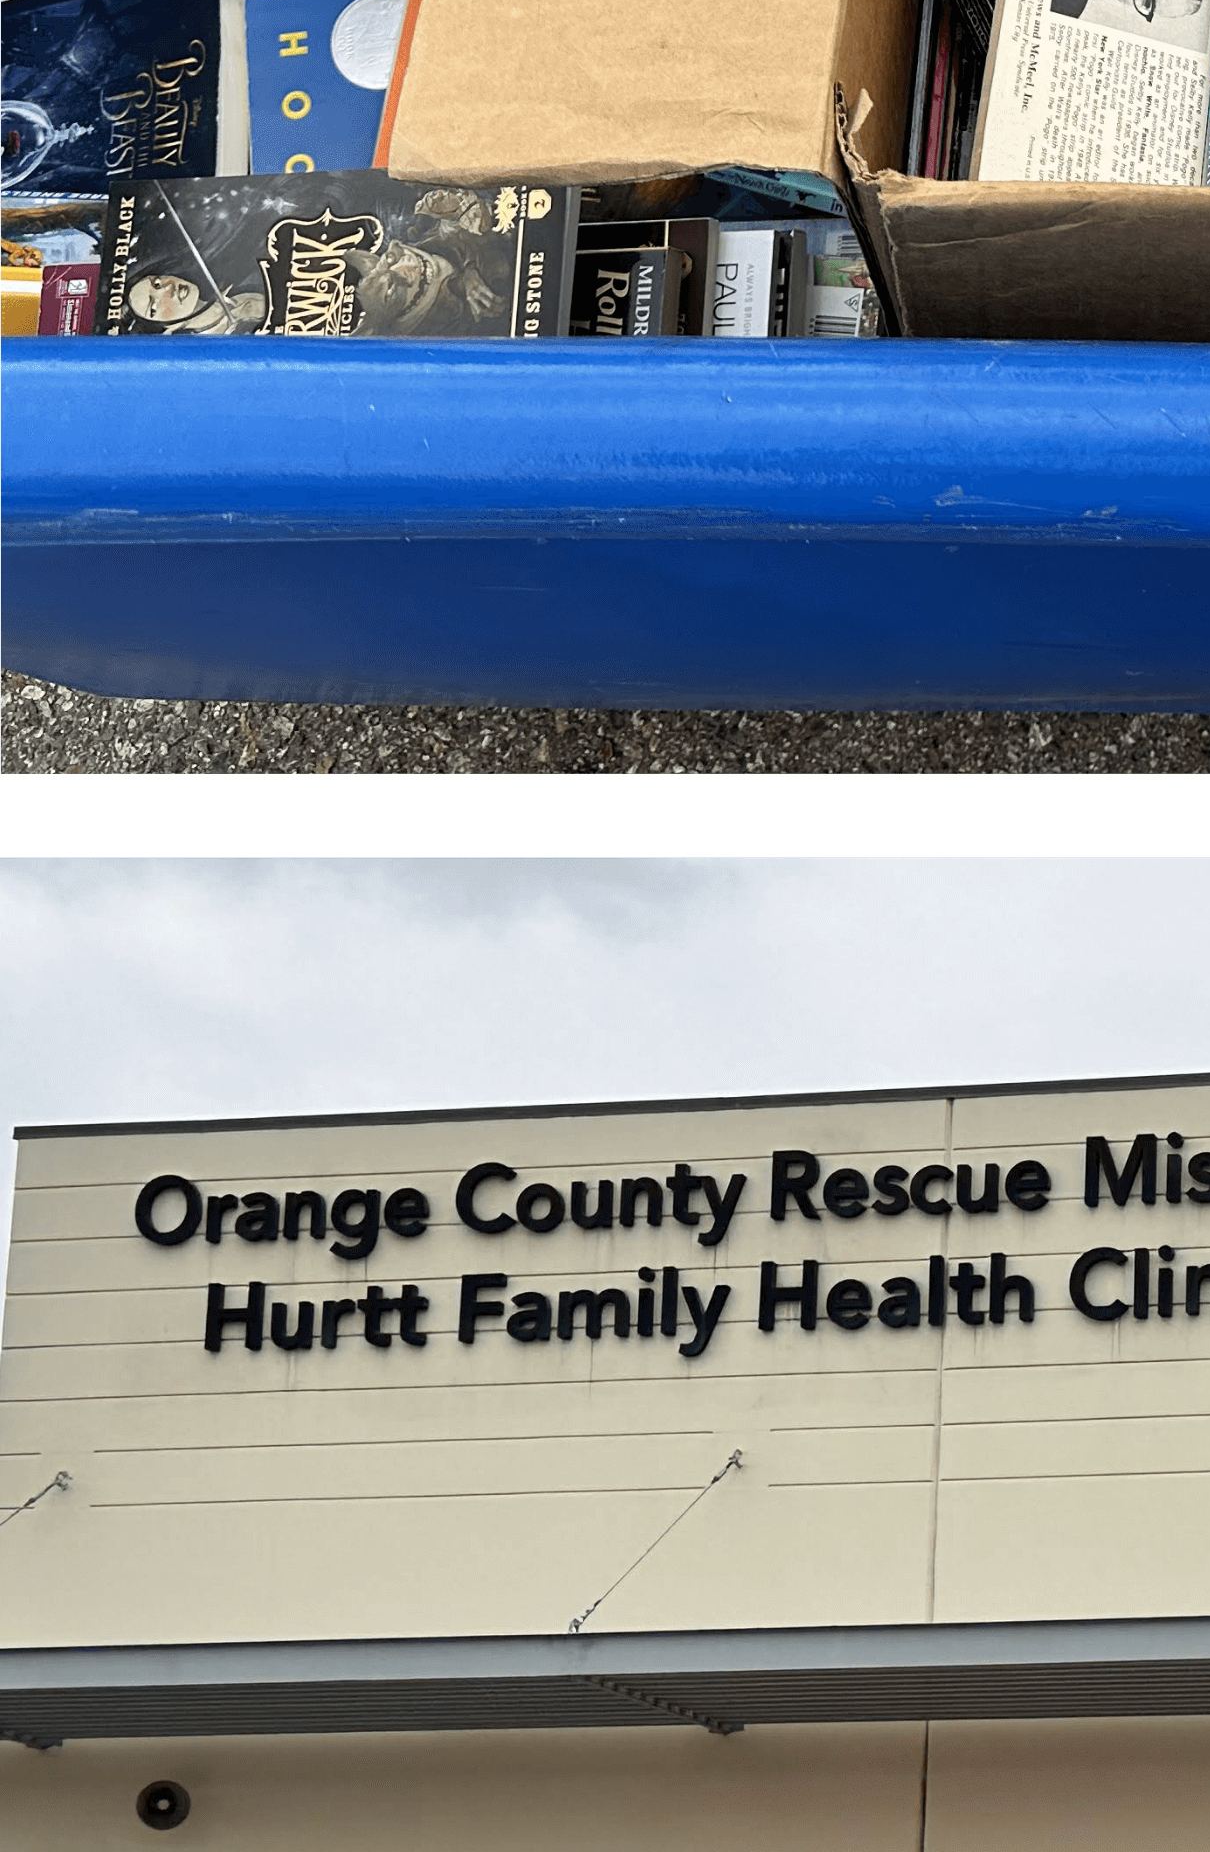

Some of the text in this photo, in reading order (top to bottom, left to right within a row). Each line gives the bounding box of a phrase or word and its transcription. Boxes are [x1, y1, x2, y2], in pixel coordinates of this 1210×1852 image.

[1032, 19, 1042, 39] and
[108, 196, 136, 321] HOLLY BLACK
[526, 251, 545, 318] STONE
[744, 263, 755, 301] ALWAYS
[134, 1173, 432, 1259] Orange
[454, 1160, 747, 1247] County
[770, 1150, 1052, 1221] Rescue
[203, 1278, 430, 1352] Hurtt
[458, 1264, 732, 1356] Family
[757, 1251, 1037, 1333] Health
